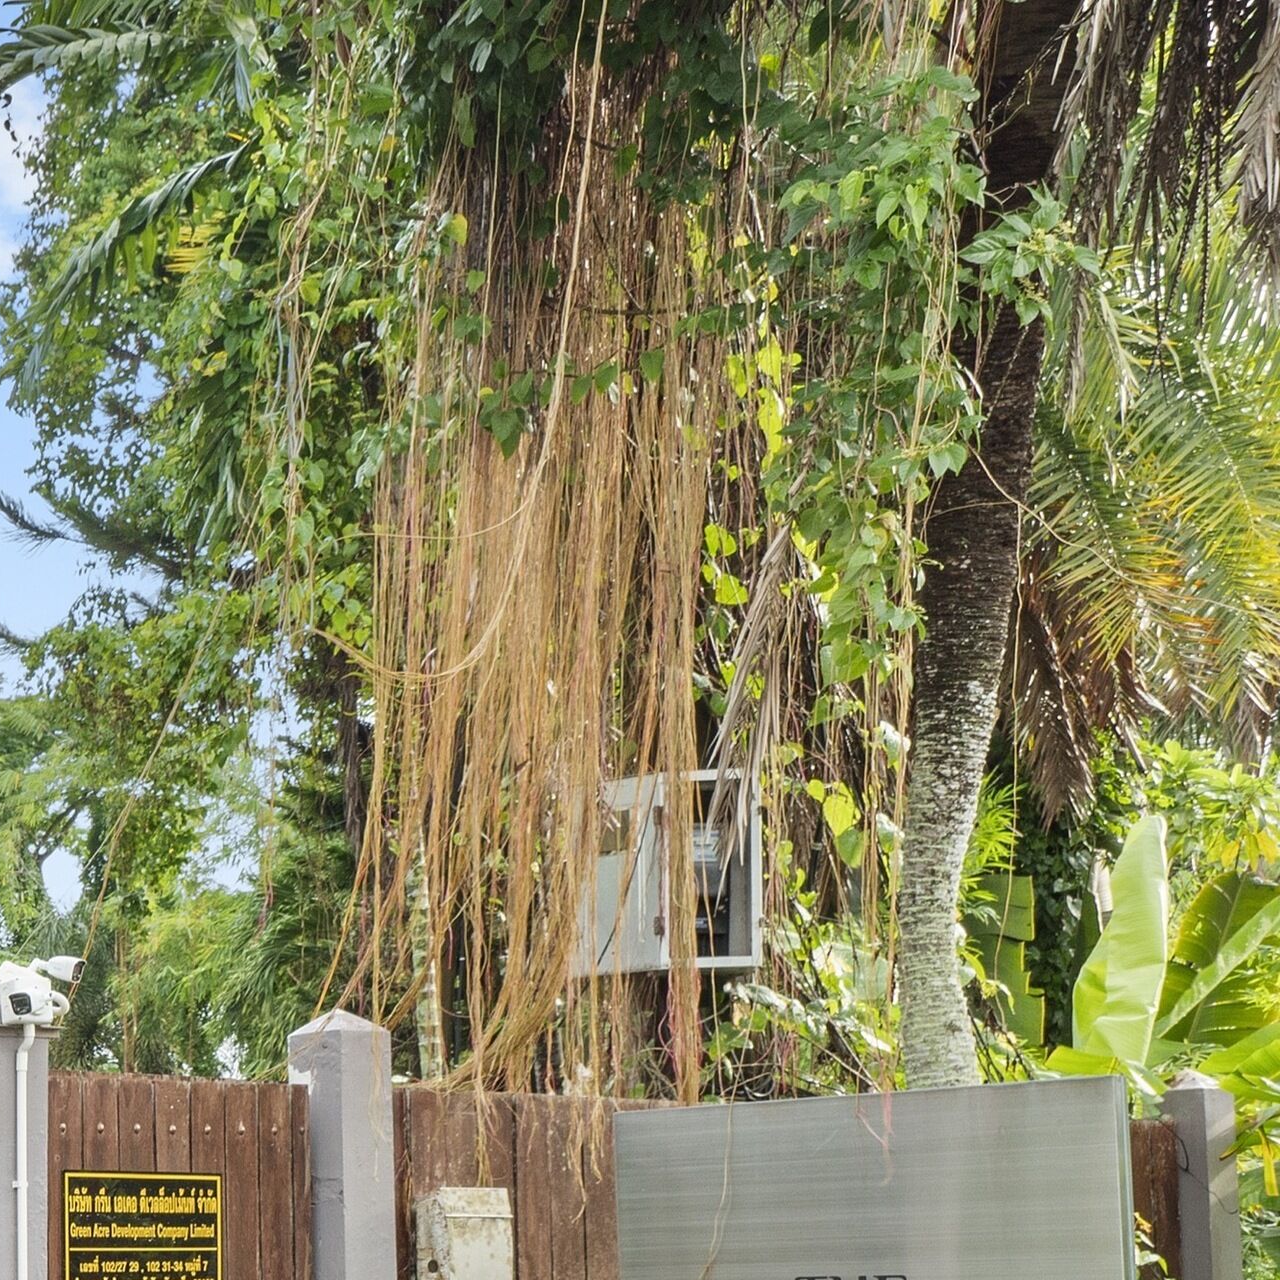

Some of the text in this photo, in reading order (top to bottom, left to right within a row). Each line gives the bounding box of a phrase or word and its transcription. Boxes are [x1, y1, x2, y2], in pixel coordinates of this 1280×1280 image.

[69, 1186, 92, 1213] บริษัท
[94, 1187, 111, 1213] กรีน
[197, 1188, 217, 1214] จำกัด
[70, 1223, 215, 1241] Green Acre Development Company Limited
[79, 1255, 99, 1273] เลขที่
[101, 1260, 127, 1273] 102/27
[128, 1260, 139, 1273] 29
[145, 1260, 160, 1272] 102
[161, 1260, 183, 1272] 31-34
[202, 1260, 209, 1272] 7
